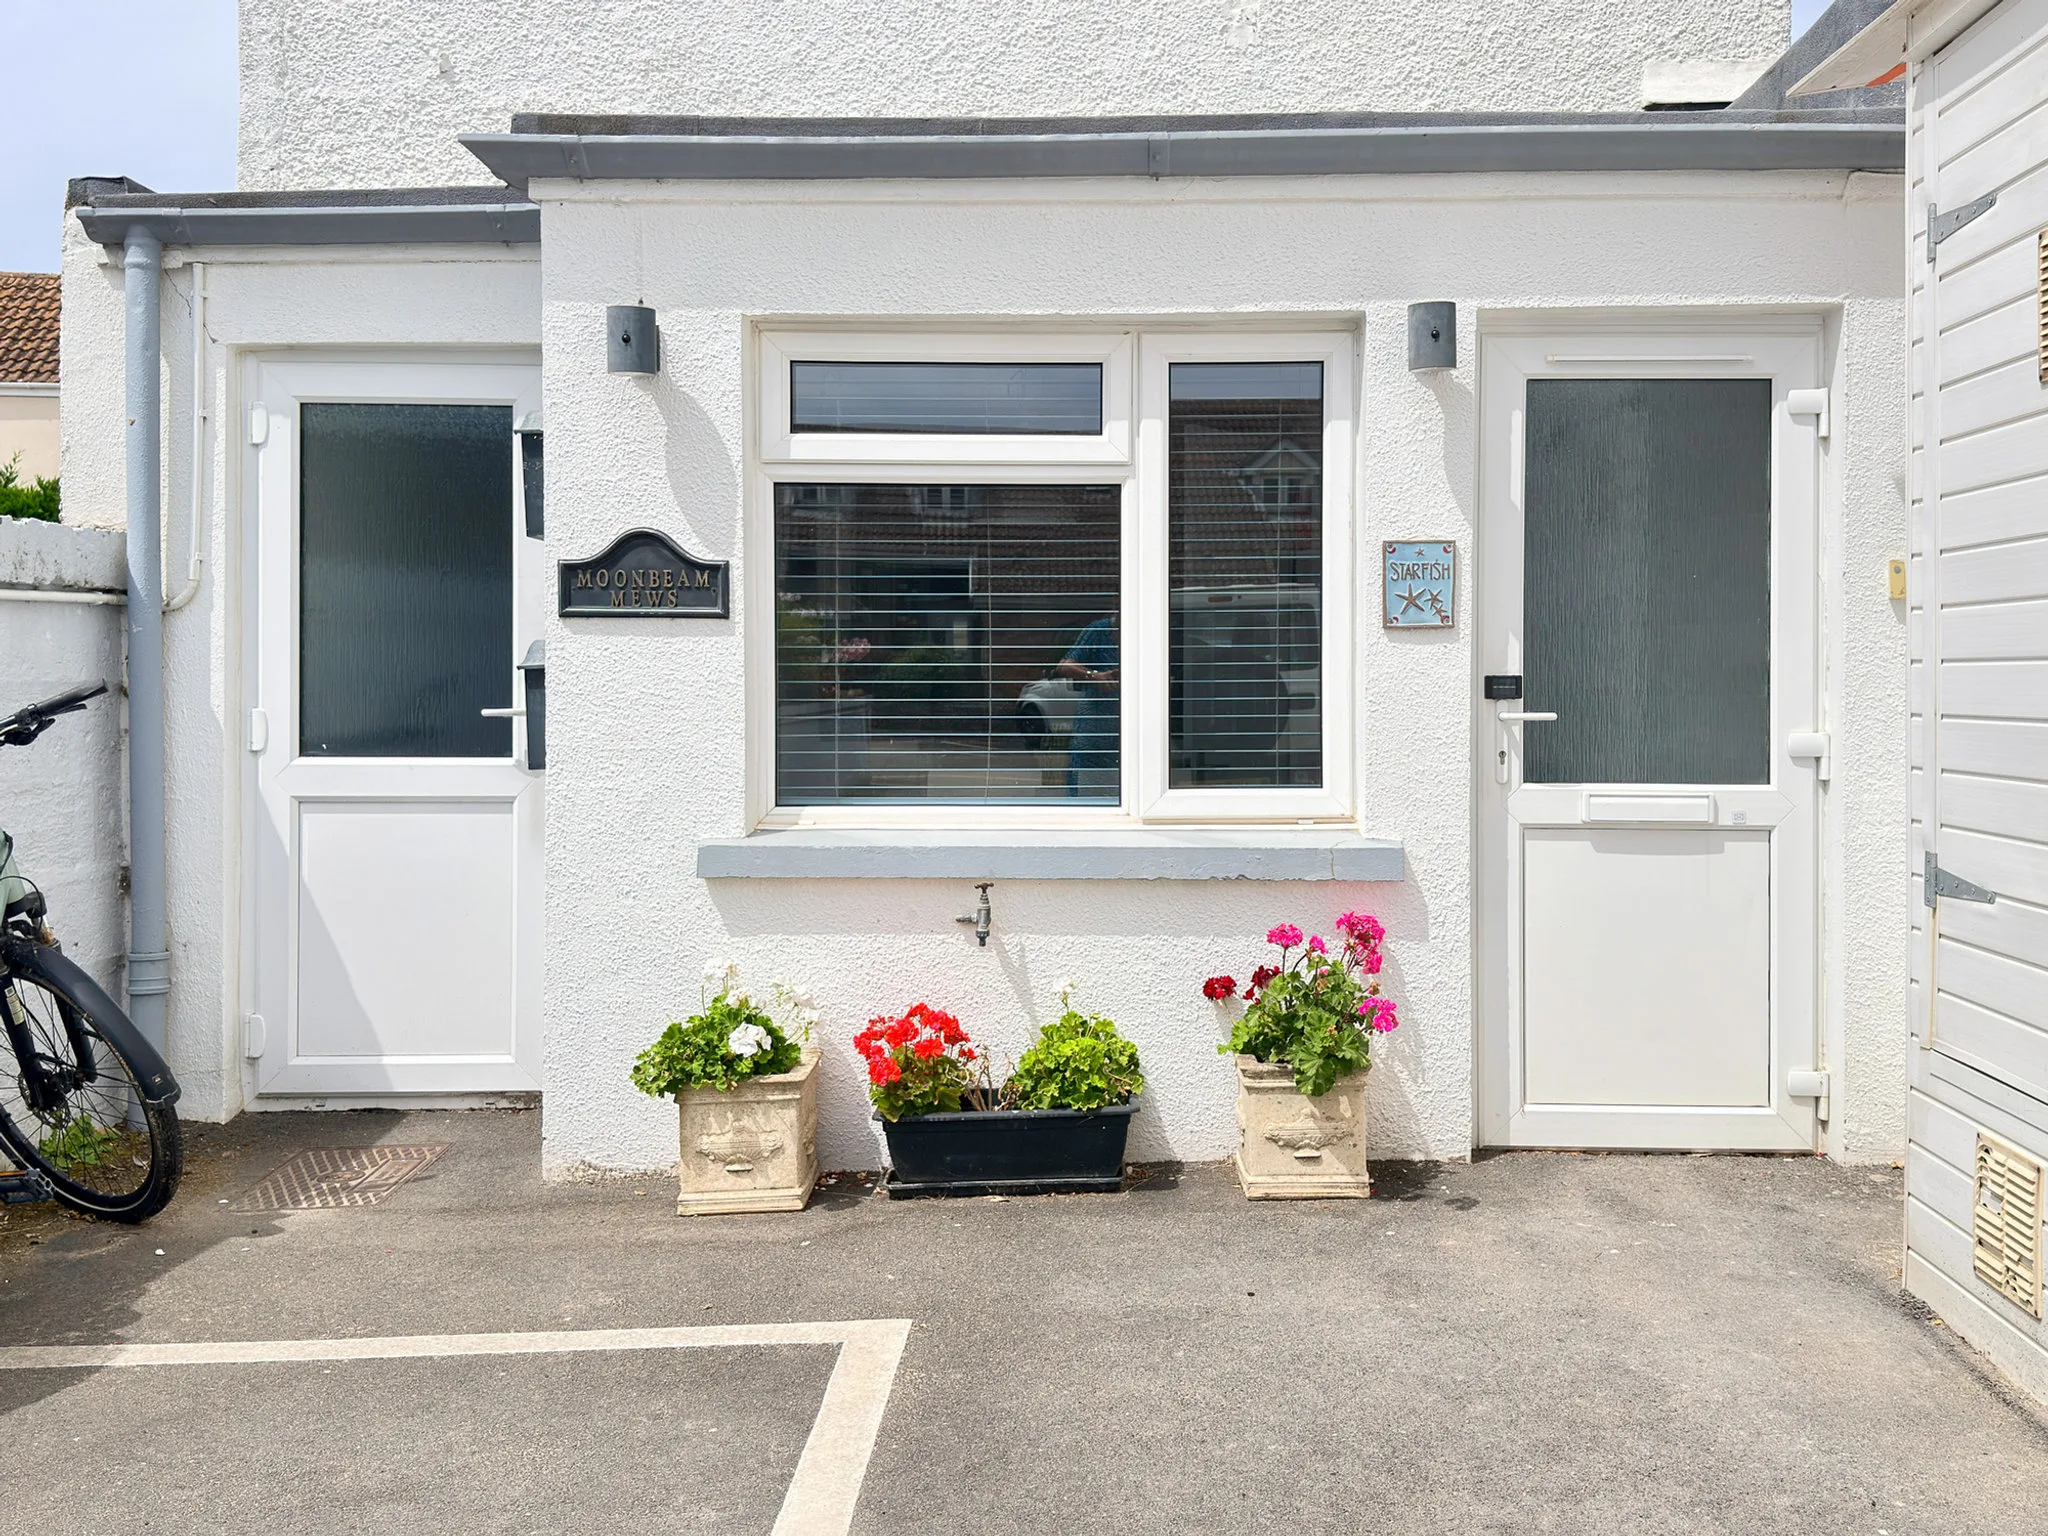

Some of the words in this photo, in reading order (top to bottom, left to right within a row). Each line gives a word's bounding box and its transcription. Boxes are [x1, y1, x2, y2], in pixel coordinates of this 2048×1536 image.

[577, 569, 710, 588] MOONBEAM
[1389, 560, 1450, 582] STARFISH
[609, 589, 678, 608] MEWS
